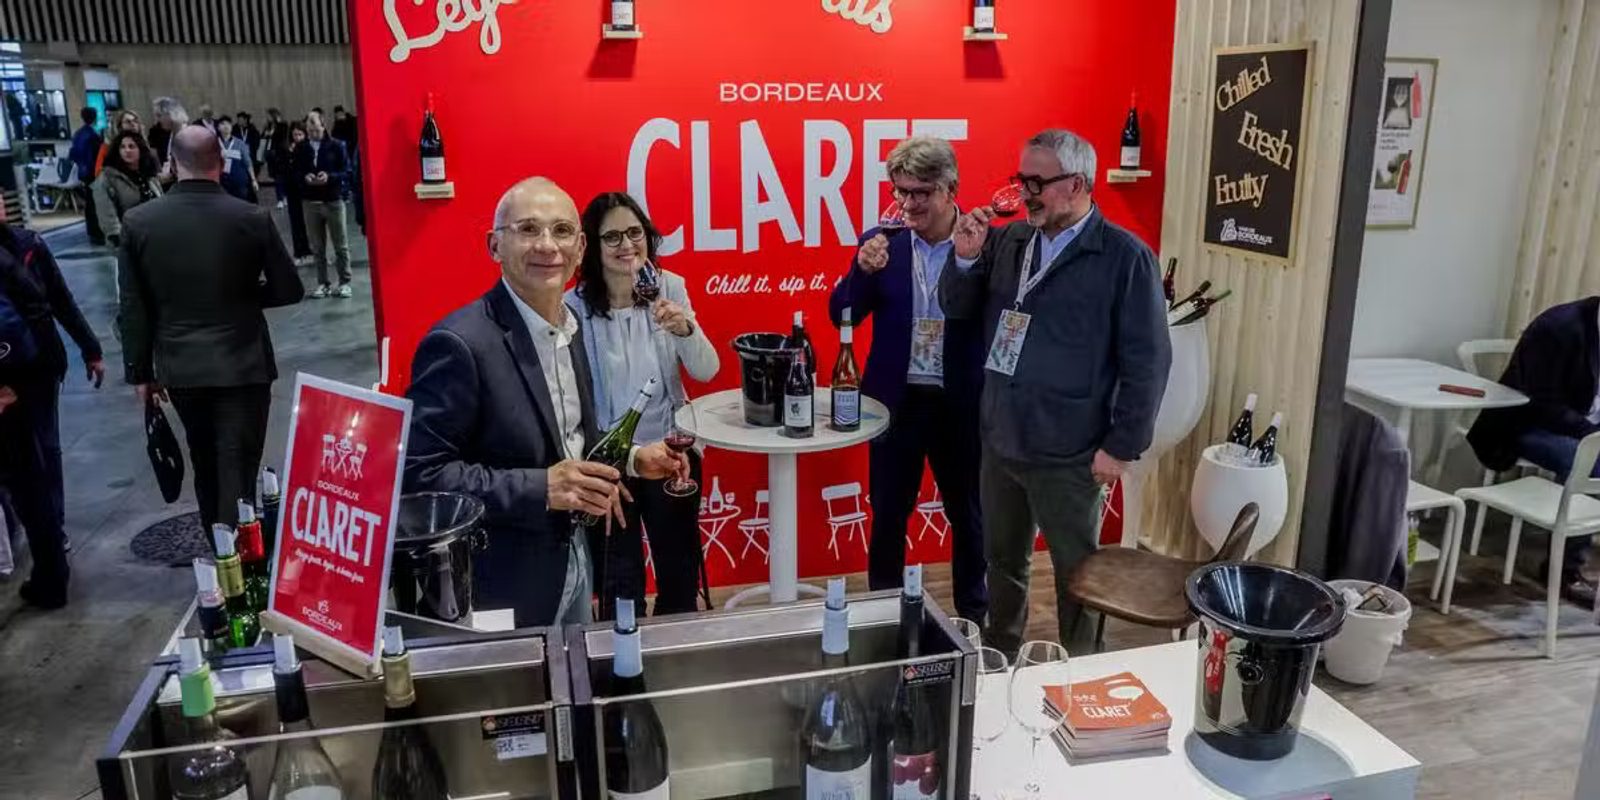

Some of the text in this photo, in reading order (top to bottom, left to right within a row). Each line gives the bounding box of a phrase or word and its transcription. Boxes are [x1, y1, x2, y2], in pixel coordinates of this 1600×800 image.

[719, 83, 883, 101] BORDEAUX
[1216, 56, 1272, 111] Chilled
[1237, 111, 1294, 170] Fresh
[1215, 172, 1269, 208] Fruity
[1238, 231, 1273, 243] BORDEAUX
[705, 274, 752, 294] Chill
[779, 275, 805, 296] sip
[317, 479, 360, 501] BORDEAUX
[291, 487, 382, 567] CLARET
[302, 606, 343, 631] BORDEAUX
[1083, 704, 1133, 718] CLARET
